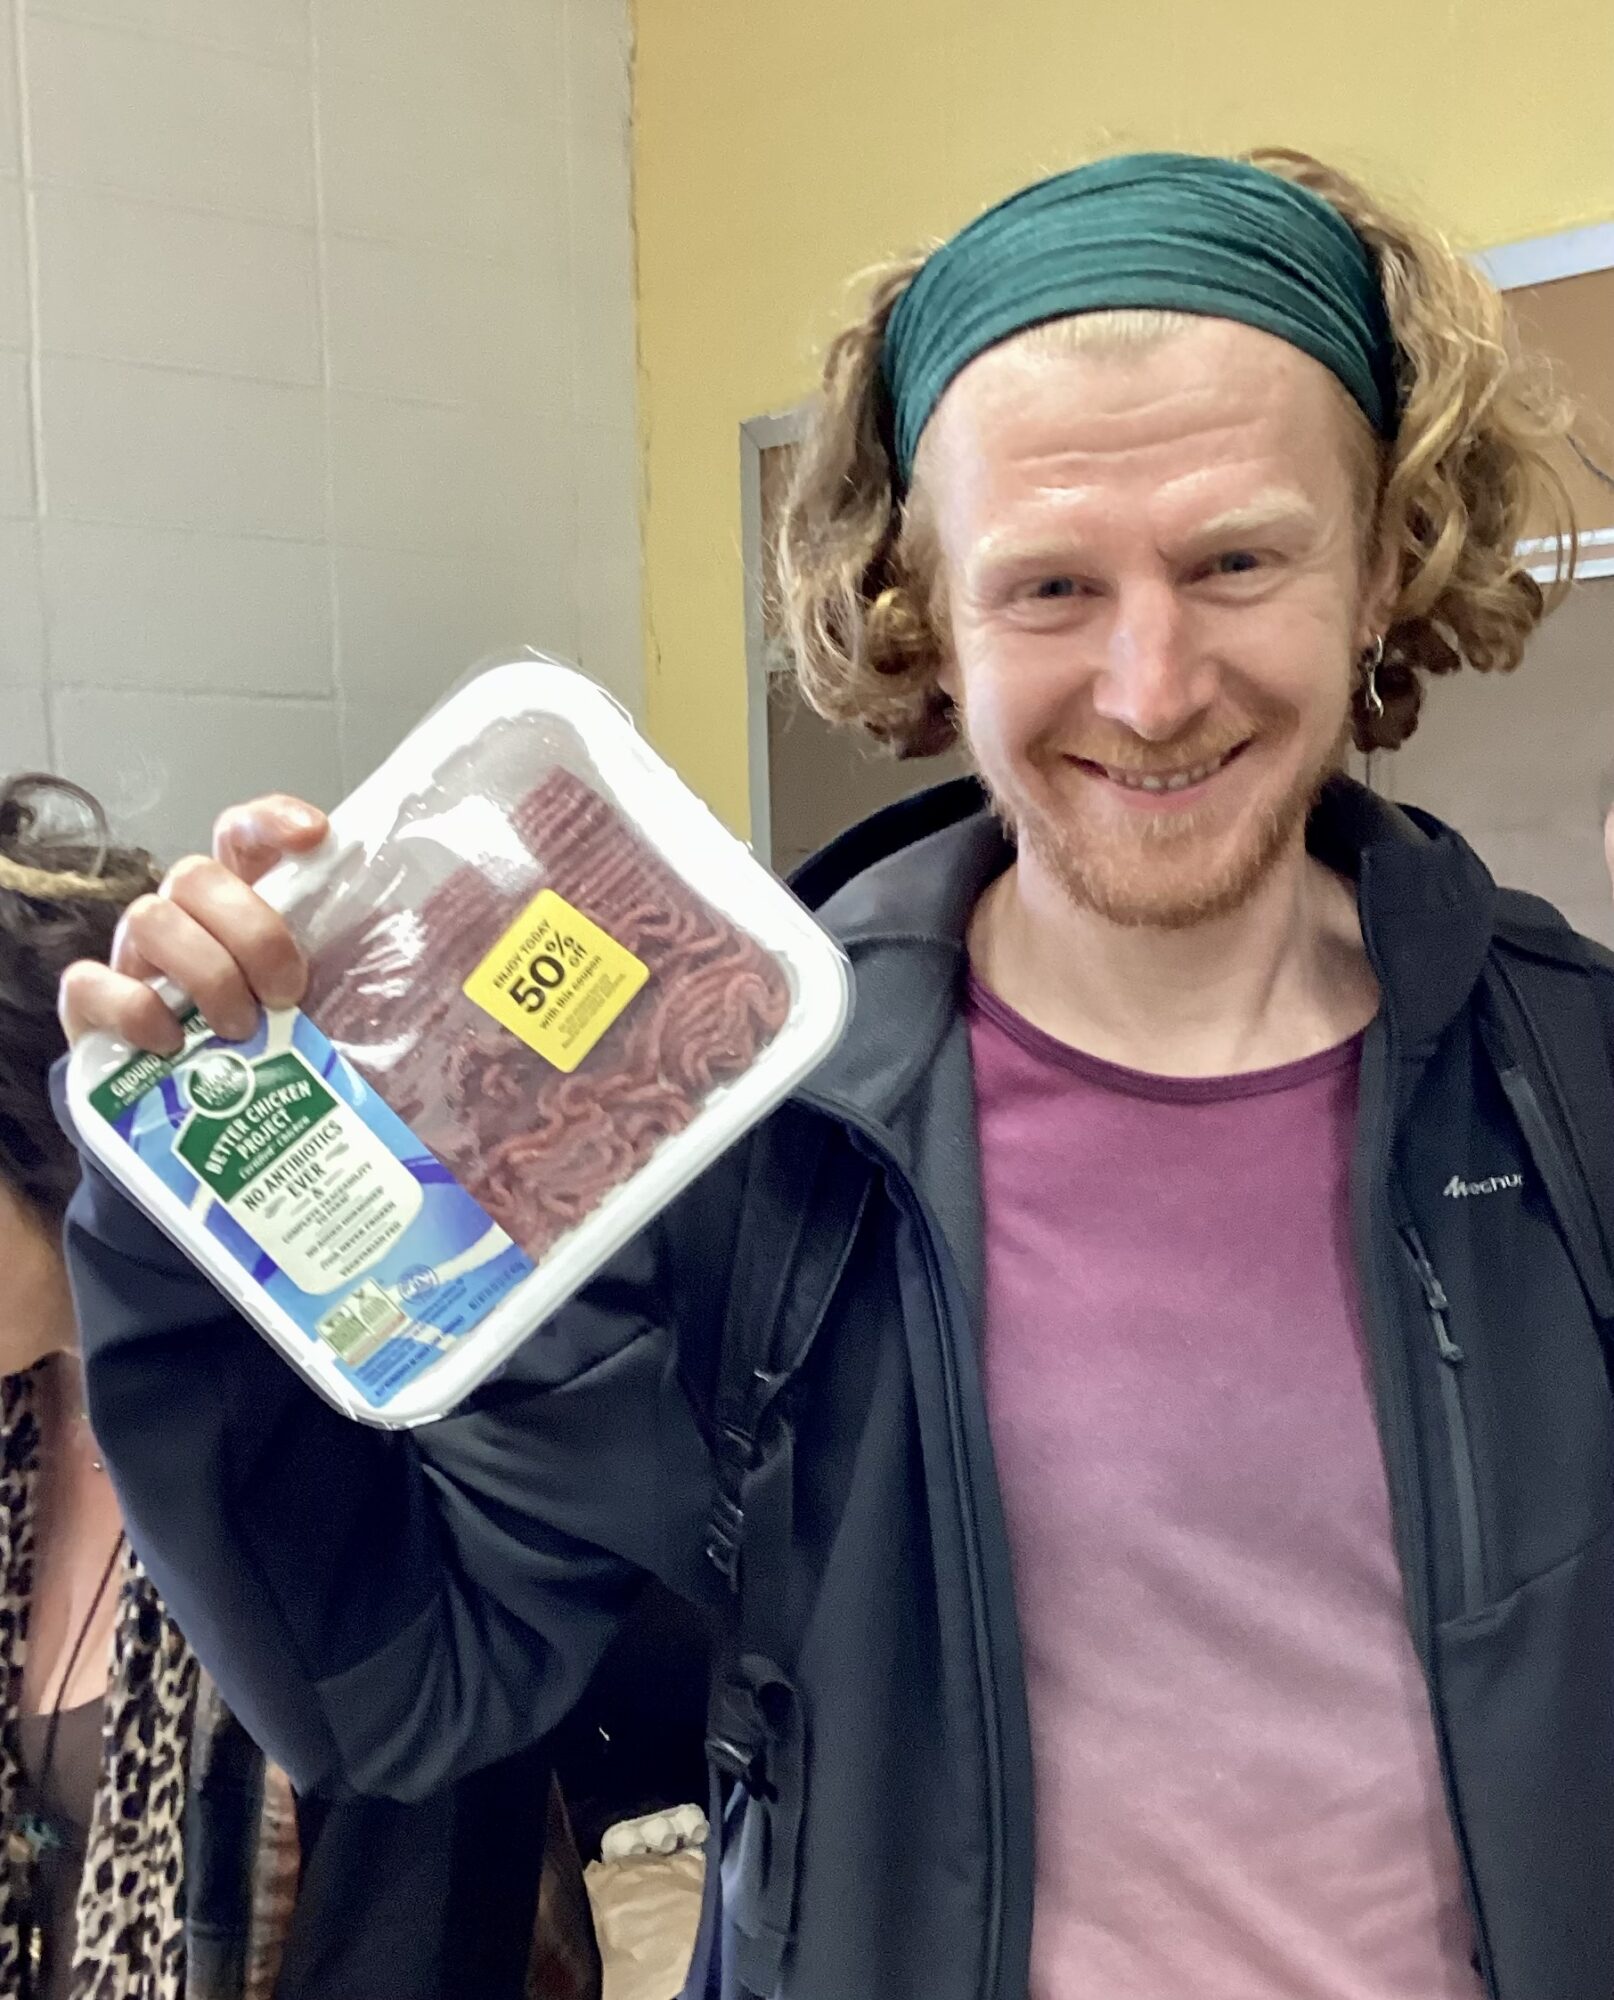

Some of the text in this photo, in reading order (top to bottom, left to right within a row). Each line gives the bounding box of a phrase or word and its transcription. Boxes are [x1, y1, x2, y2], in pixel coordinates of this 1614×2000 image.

[493, 918, 551, 989] ENJOY TODAY
[508, 930, 575, 1014] 50%
[568, 943, 588, 968] off
[539, 954, 603, 1030] with this coupon
[110, 1054, 162, 1097] GROUND
[204, 1117, 251, 1175] BETTER
[244, 1080, 313, 1123] CHICKEN
[235, 1108, 294, 1161] PROJECT
[243, 1119, 343, 1212] NO ANTIBIOTICS
[286, 1162, 327, 1199] EVER
